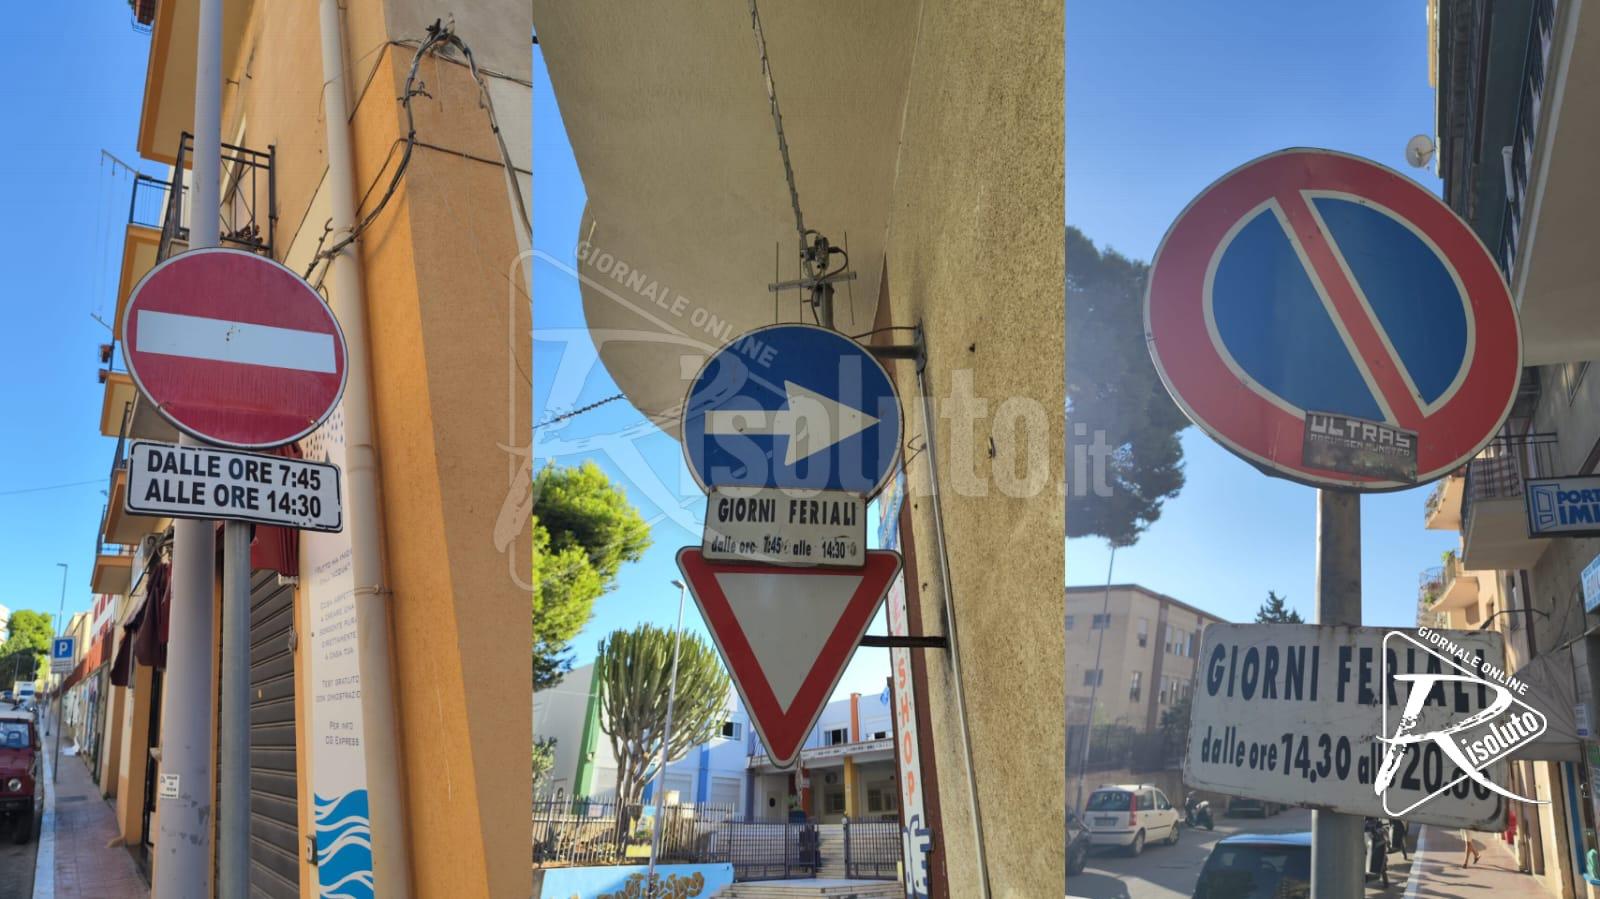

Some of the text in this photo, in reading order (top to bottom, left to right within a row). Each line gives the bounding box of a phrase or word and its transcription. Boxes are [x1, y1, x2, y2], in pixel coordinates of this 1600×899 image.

[1311, 415, 1411, 449] ULTRAS
[147, 450, 321, 491] DALLE ORE 7:45
[144, 479, 321, 518] ALLE ORE 14:30
[717, 498, 856, 526] GIORNI FERIALI
[711, 536, 736, 553] dalle
[792, 540, 812, 556] alle
[822, 541, 846, 559] 14:30
[1207, 643, 1320, 702] GIORNI
[896, 657, 917, 807] SHOP
[1201, 726, 1245, 767] dalle
[1249, 736, 1278, 771] ore
[1280, 732, 1352, 783] 14.30
